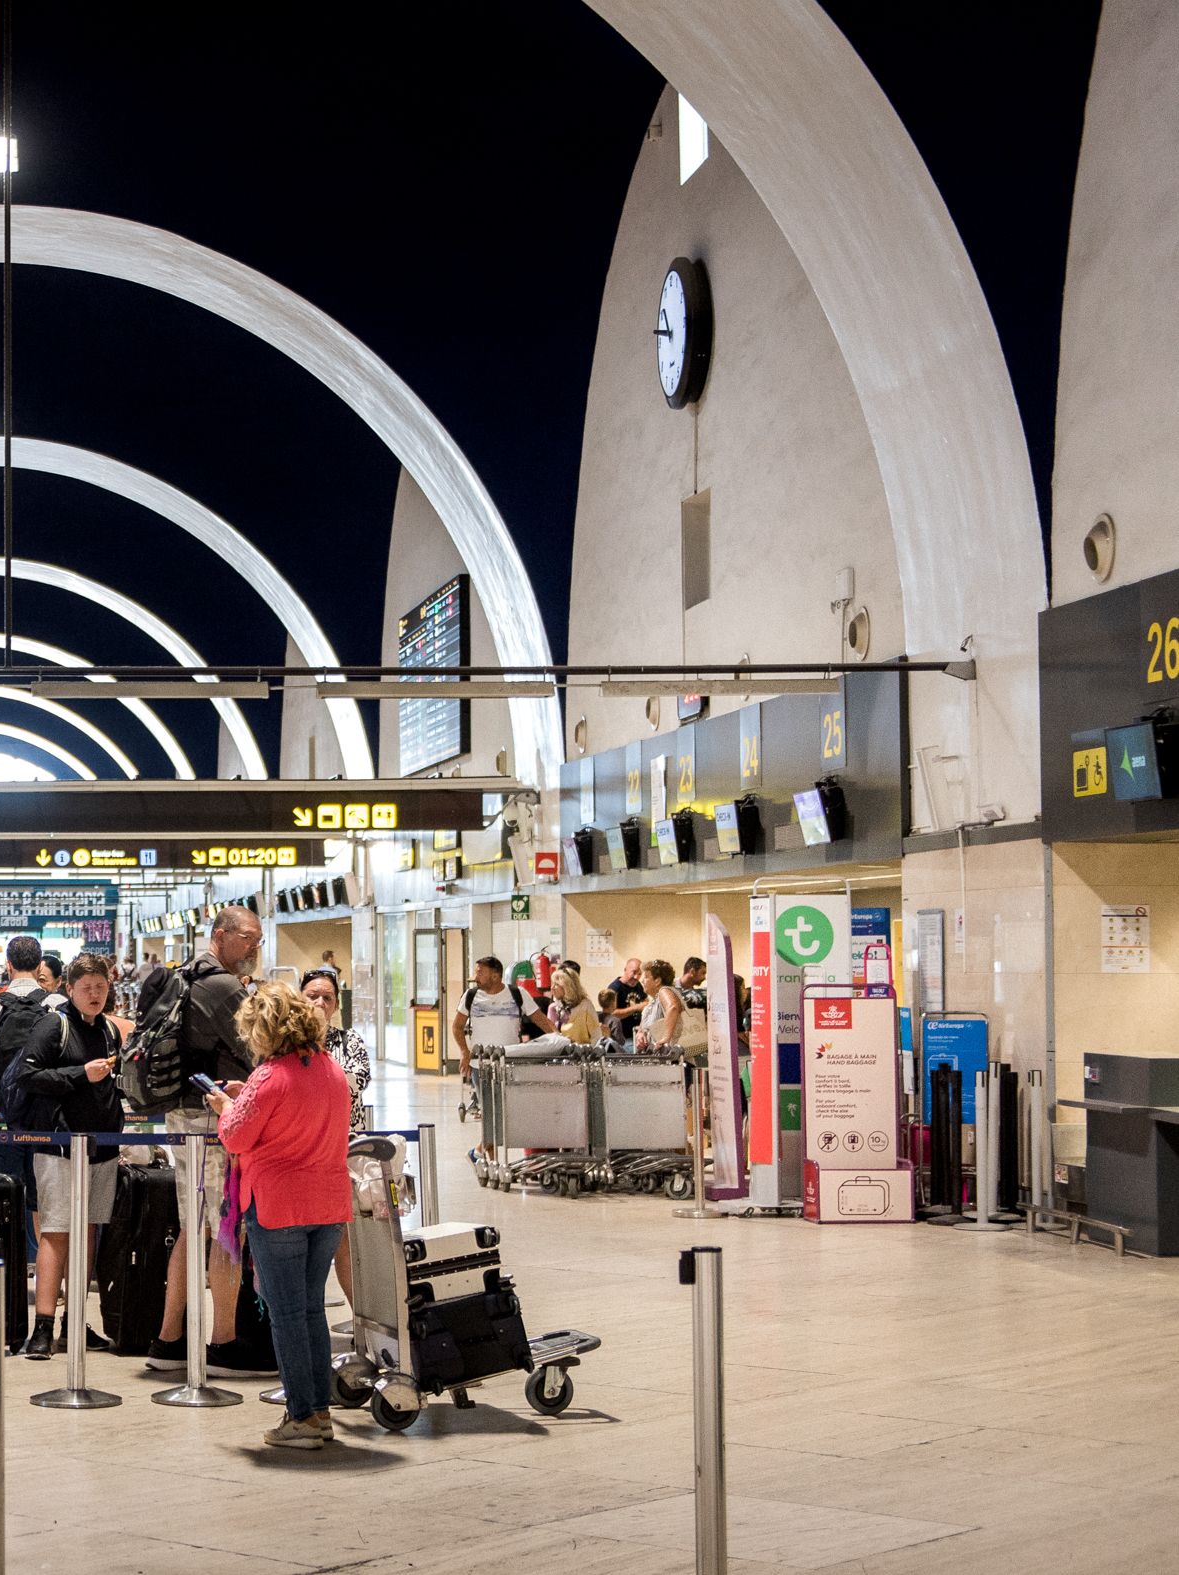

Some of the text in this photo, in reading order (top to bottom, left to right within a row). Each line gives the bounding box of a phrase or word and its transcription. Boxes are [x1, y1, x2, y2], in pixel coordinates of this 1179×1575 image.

[1146, 616, 1179, 683] 26
[823, 710, 842, 758] 25
[679, 755, 693, 793] 23
[742, 735, 759, 777] 24
[627, 768, 640, 804] 22
[13, 1134, 51, 1142] Lufthansa
